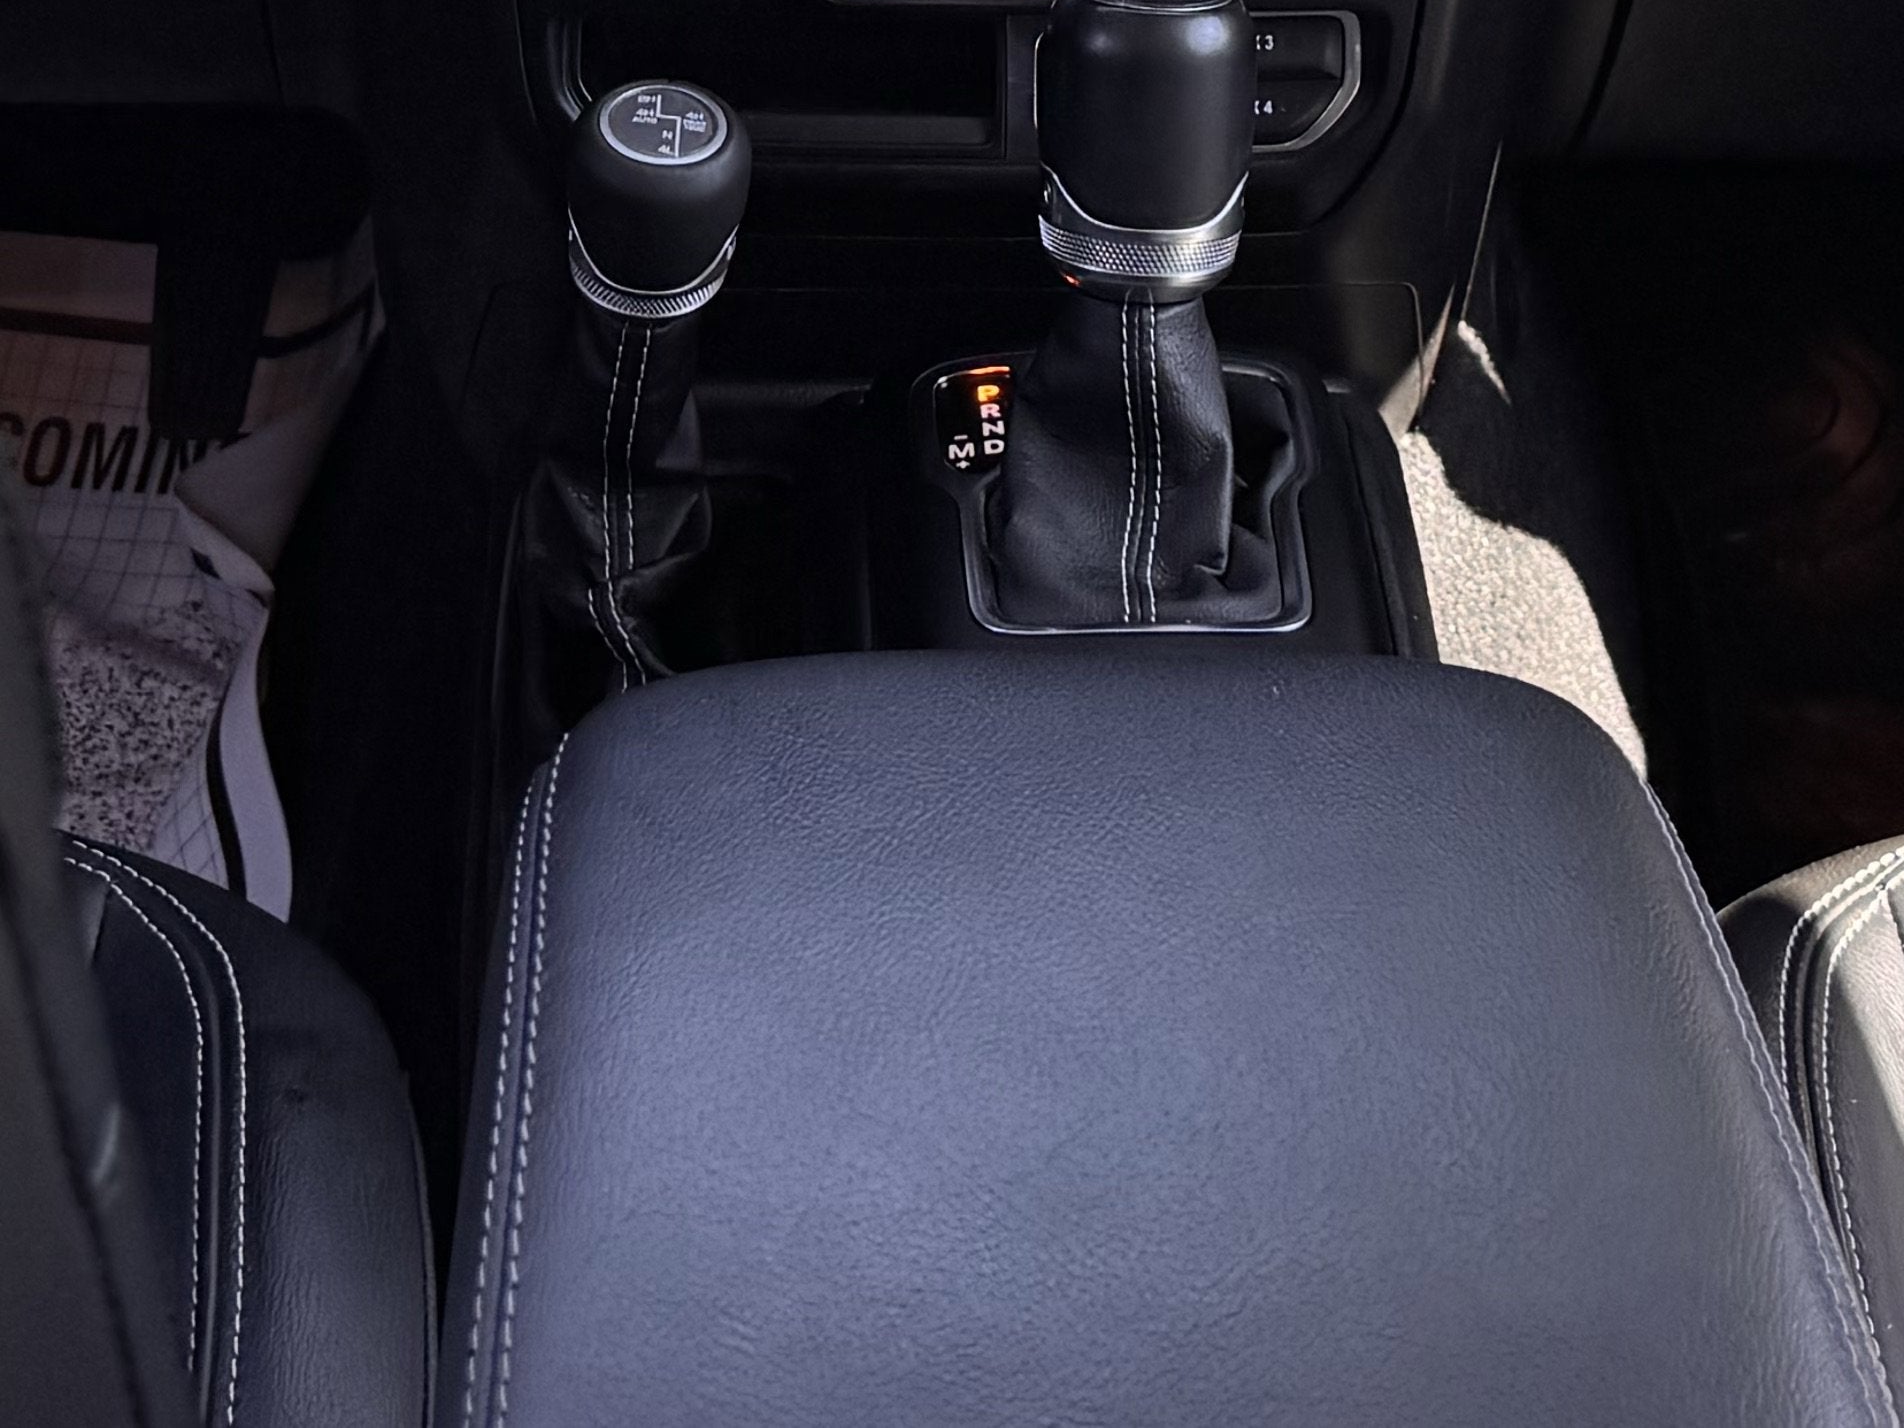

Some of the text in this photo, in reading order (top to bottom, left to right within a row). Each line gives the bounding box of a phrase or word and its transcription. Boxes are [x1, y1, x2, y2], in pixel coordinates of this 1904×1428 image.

[977, 384, 1000, 402] P
[980, 403, 1001, 419] R
[982, 420, 1005, 437] N
[948, 442, 975, 459] M
[984, 438, 1005, 455] D
